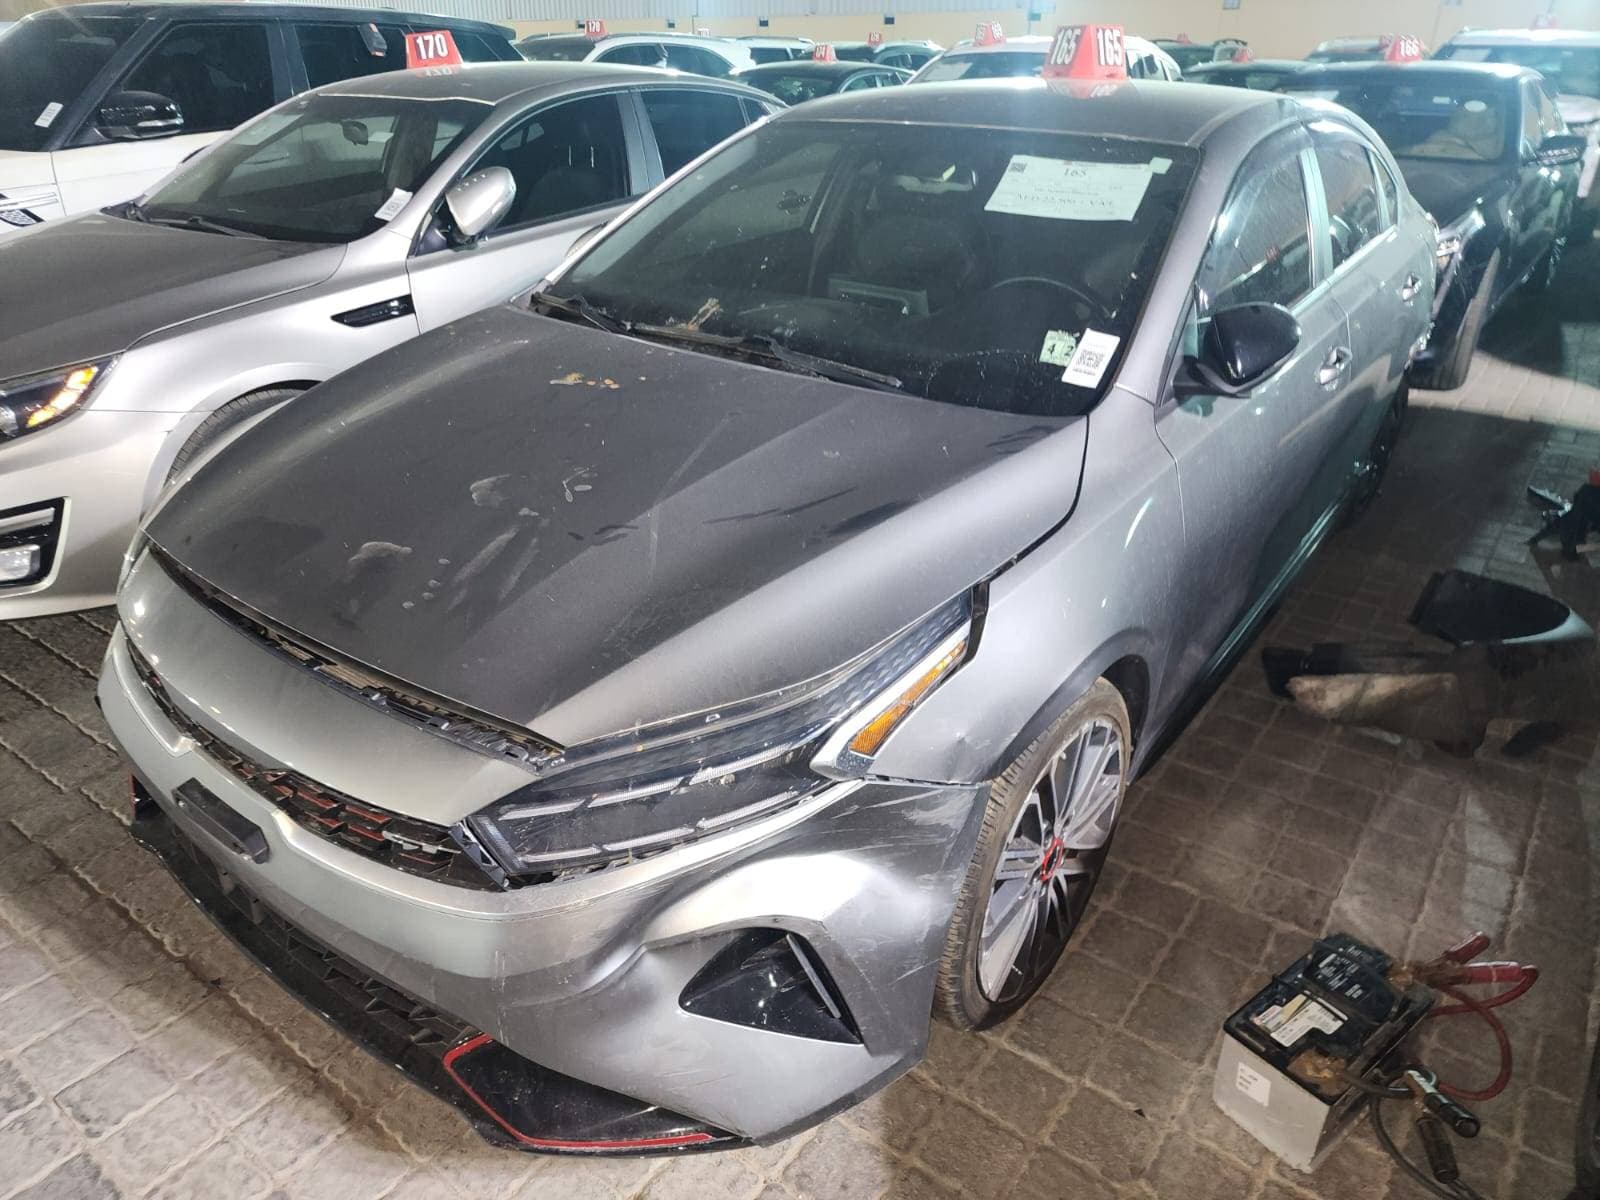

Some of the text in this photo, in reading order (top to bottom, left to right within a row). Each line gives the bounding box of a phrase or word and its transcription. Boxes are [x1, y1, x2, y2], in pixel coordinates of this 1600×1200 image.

[588, 20, 601, 33] 170
[416, 33, 449, 60] 170
[1051, 28, 1081, 65] 165
[1097, 28, 1122, 66] 165
[1064, 168, 1088, 177] 165
